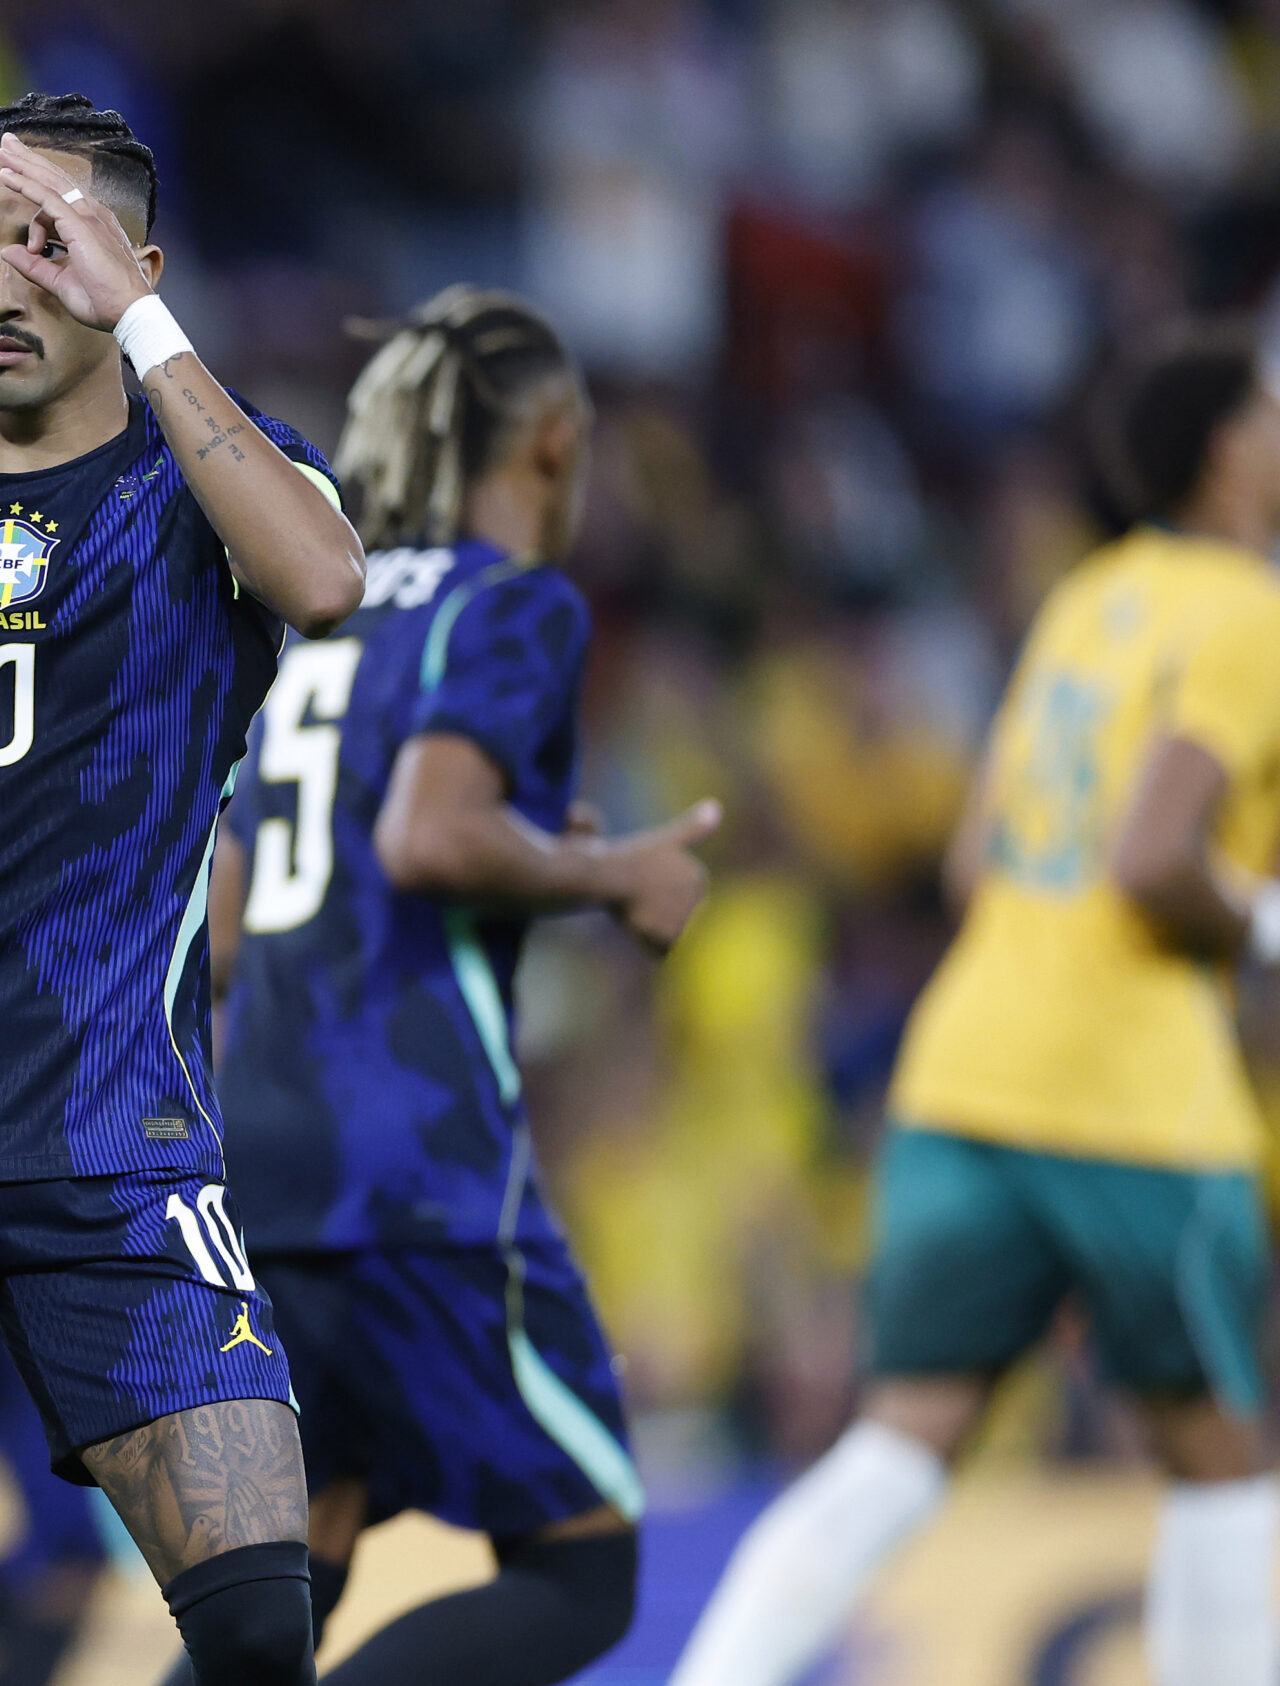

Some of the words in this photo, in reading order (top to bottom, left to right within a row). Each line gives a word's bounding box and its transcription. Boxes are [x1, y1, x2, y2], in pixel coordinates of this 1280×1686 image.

[183, 389, 205, 413] YOU
[242, 637, 363, 934] 5
[165, 1184, 256, 1291] 10
